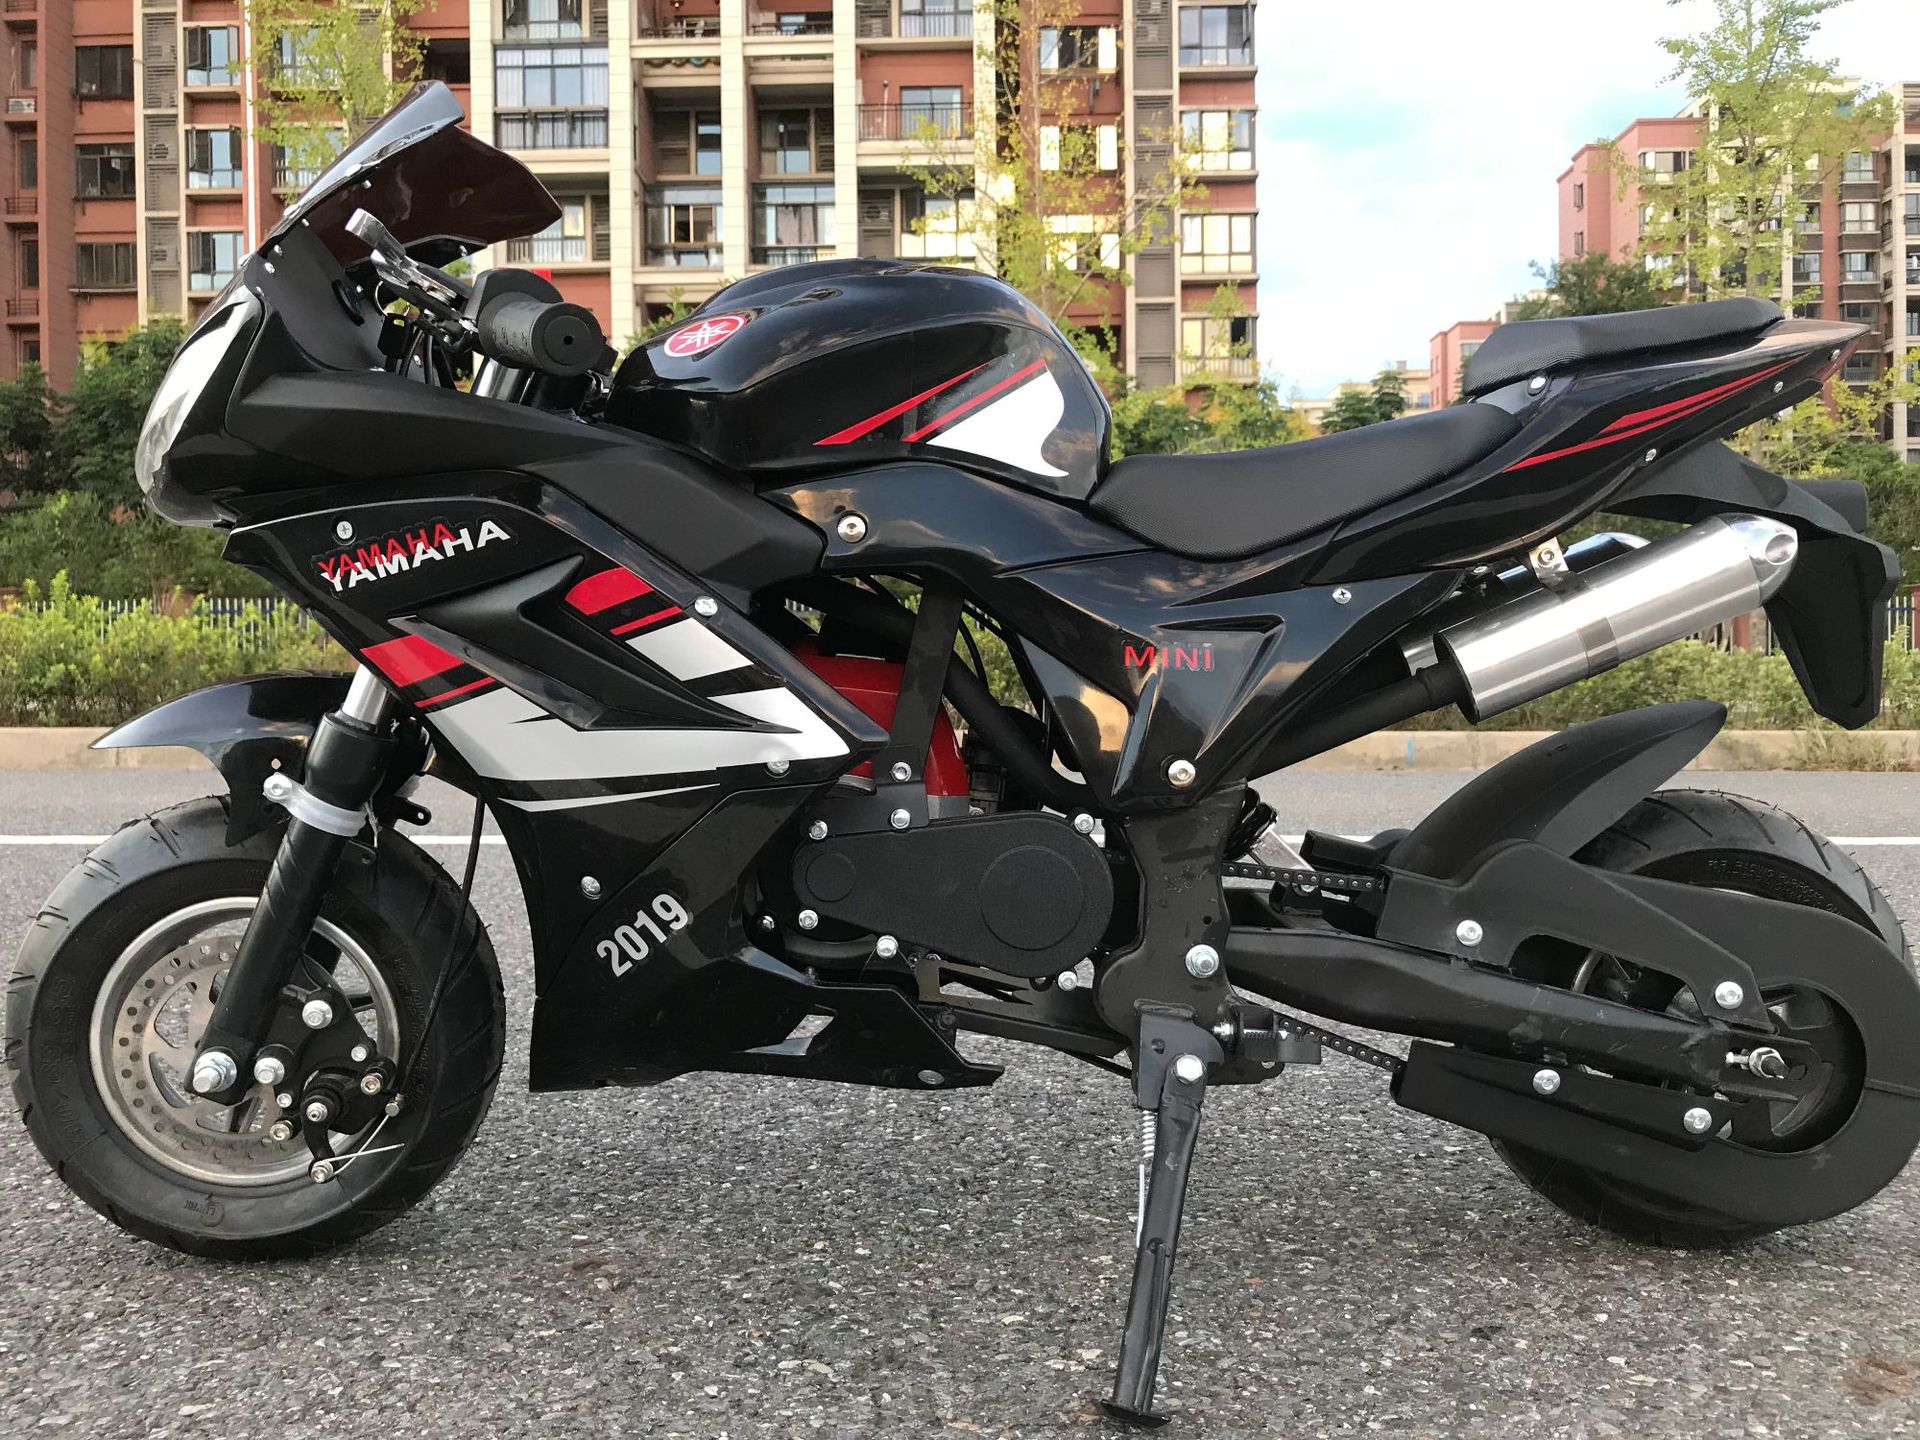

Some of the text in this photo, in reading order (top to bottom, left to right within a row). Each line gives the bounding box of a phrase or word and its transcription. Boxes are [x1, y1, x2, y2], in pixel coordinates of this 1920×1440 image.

[318, 522, 456, 580] YAMAHA
[320, 519, 511, 592] YAMAHA
[1123, 645, 1212, 669] MINI
[596, 893, 688, 977] 2019
